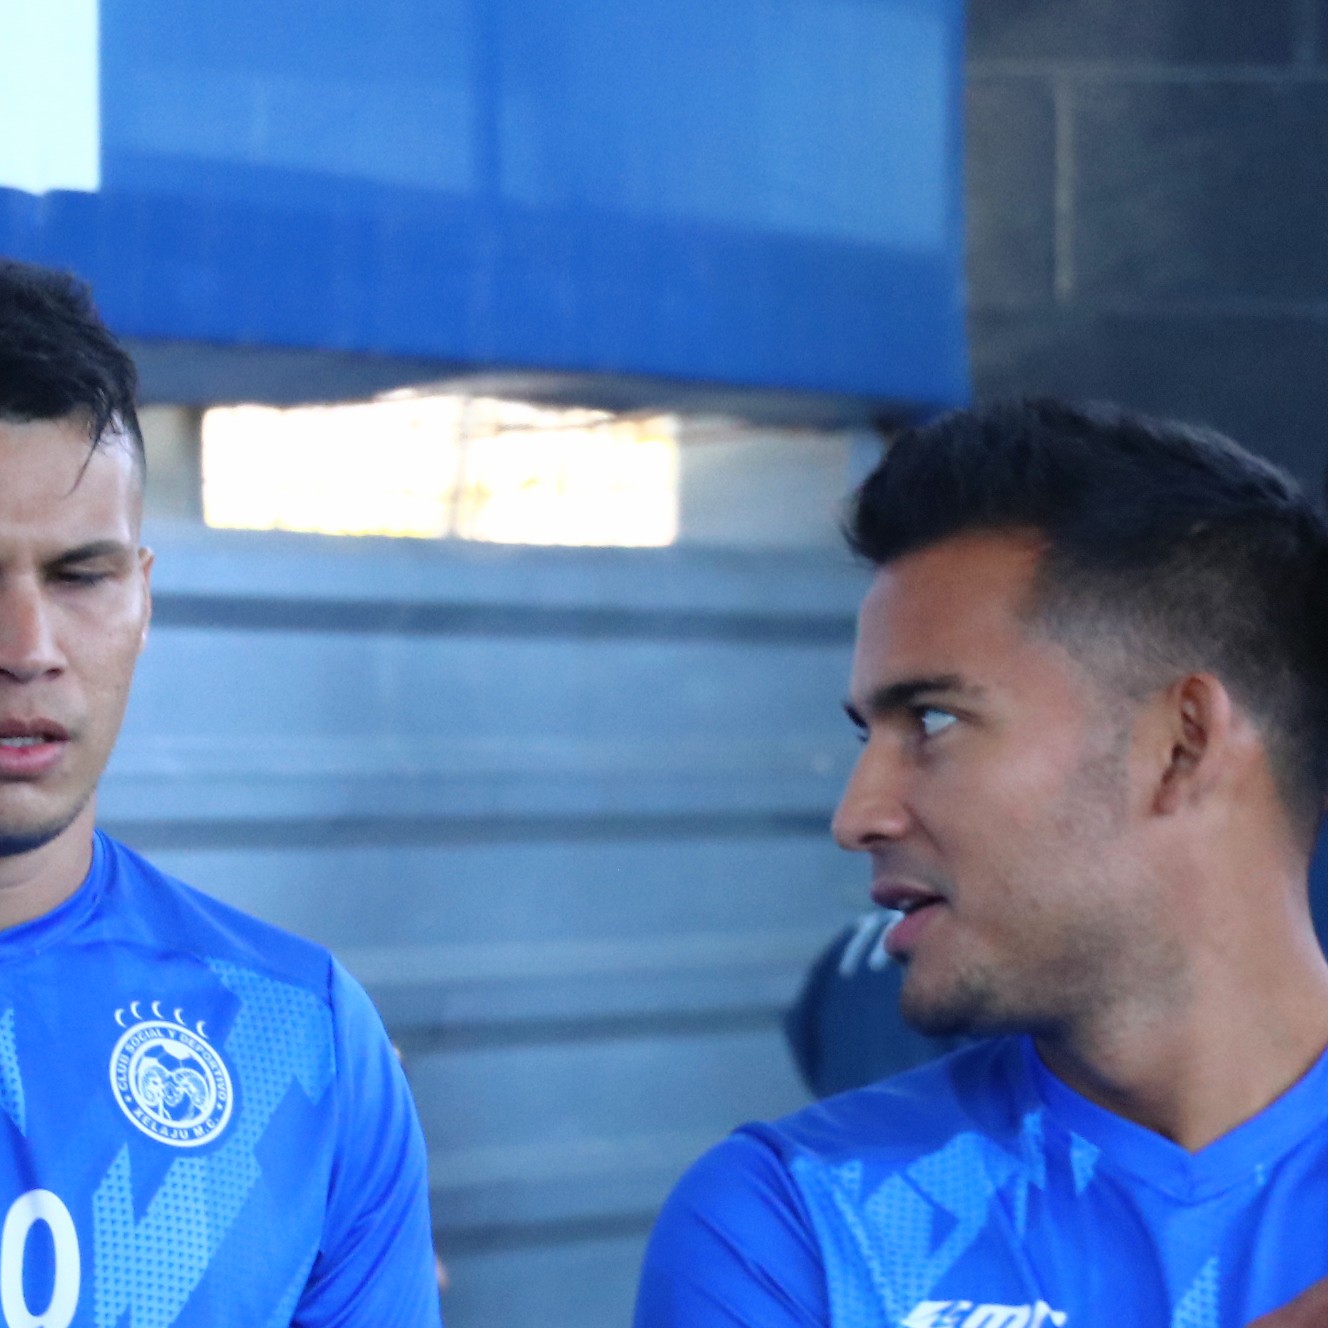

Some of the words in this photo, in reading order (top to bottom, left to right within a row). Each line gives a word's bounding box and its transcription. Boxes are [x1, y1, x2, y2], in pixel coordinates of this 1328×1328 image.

[125, 1028, 166, 1052] SOCIAL
[167, 1028, 177, 1039] Y
[179, 1033, 228, 1102] DEPORTIVO
